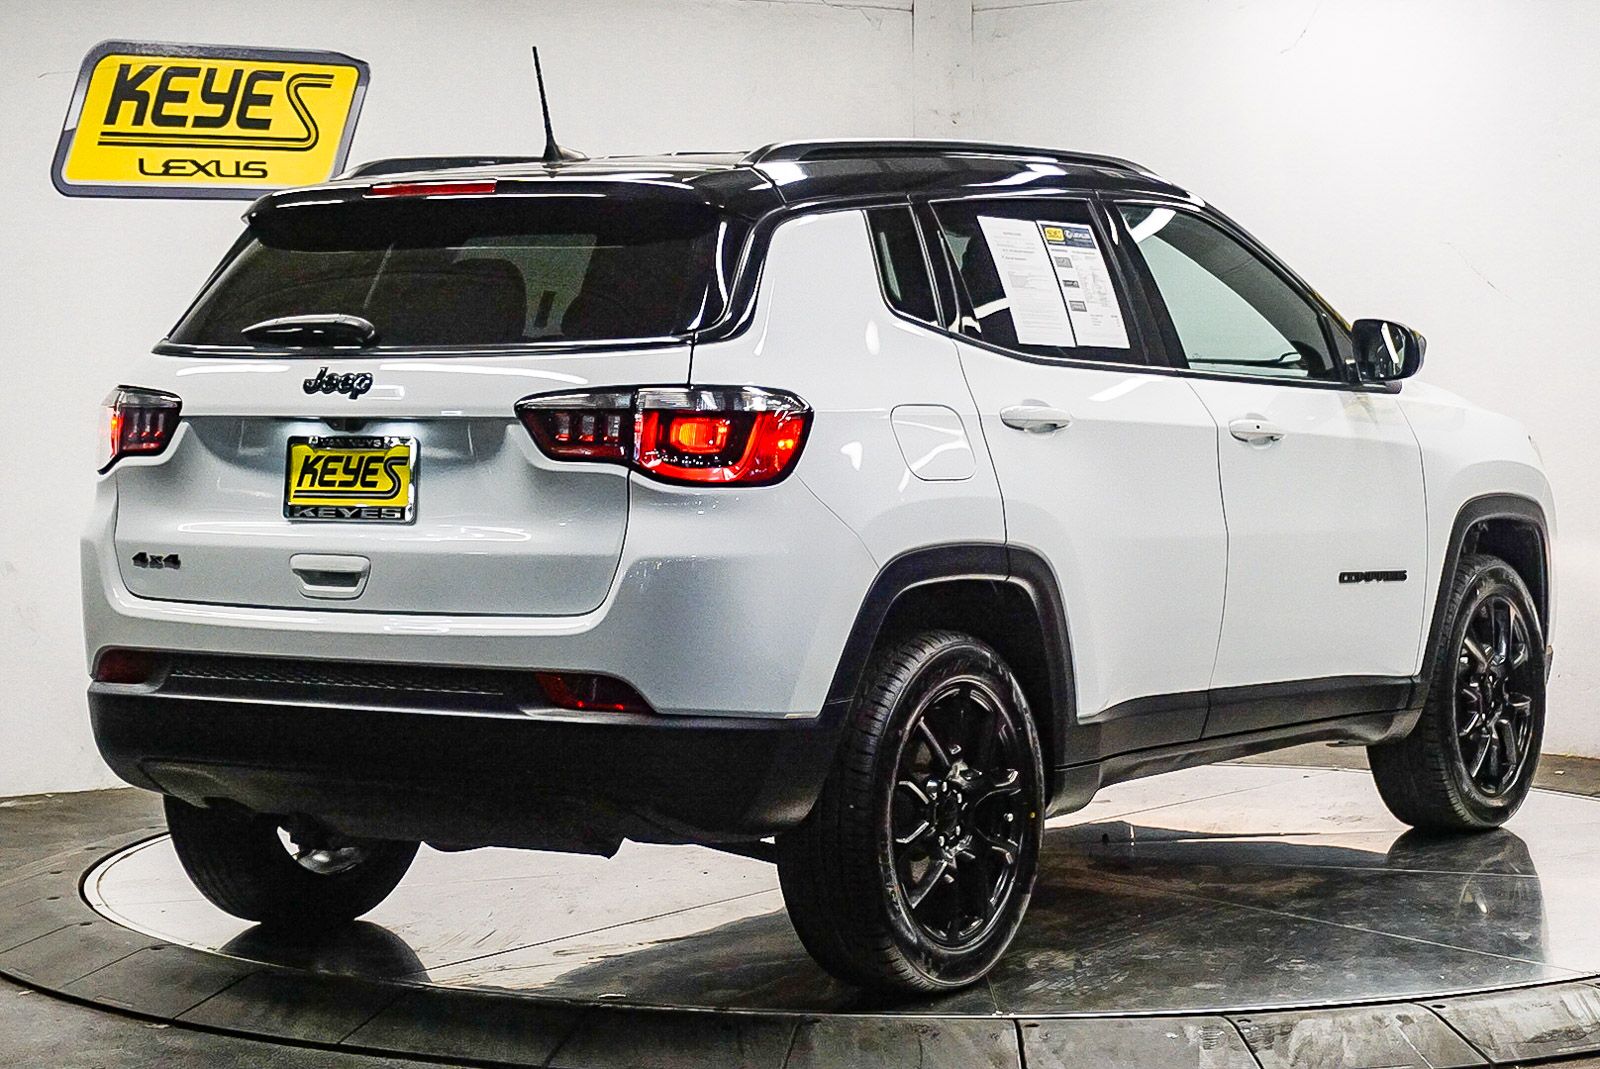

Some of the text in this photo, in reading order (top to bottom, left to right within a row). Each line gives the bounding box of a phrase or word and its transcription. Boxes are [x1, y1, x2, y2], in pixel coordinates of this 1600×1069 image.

[98, 64, 335, 152] KEYES
[138, 158, 268, 178] LEXUS
[303, 366, 373, 400] Jeep
[293, 455, 409, 500] KEYES
[293, 507, 402, 519] KEYES
